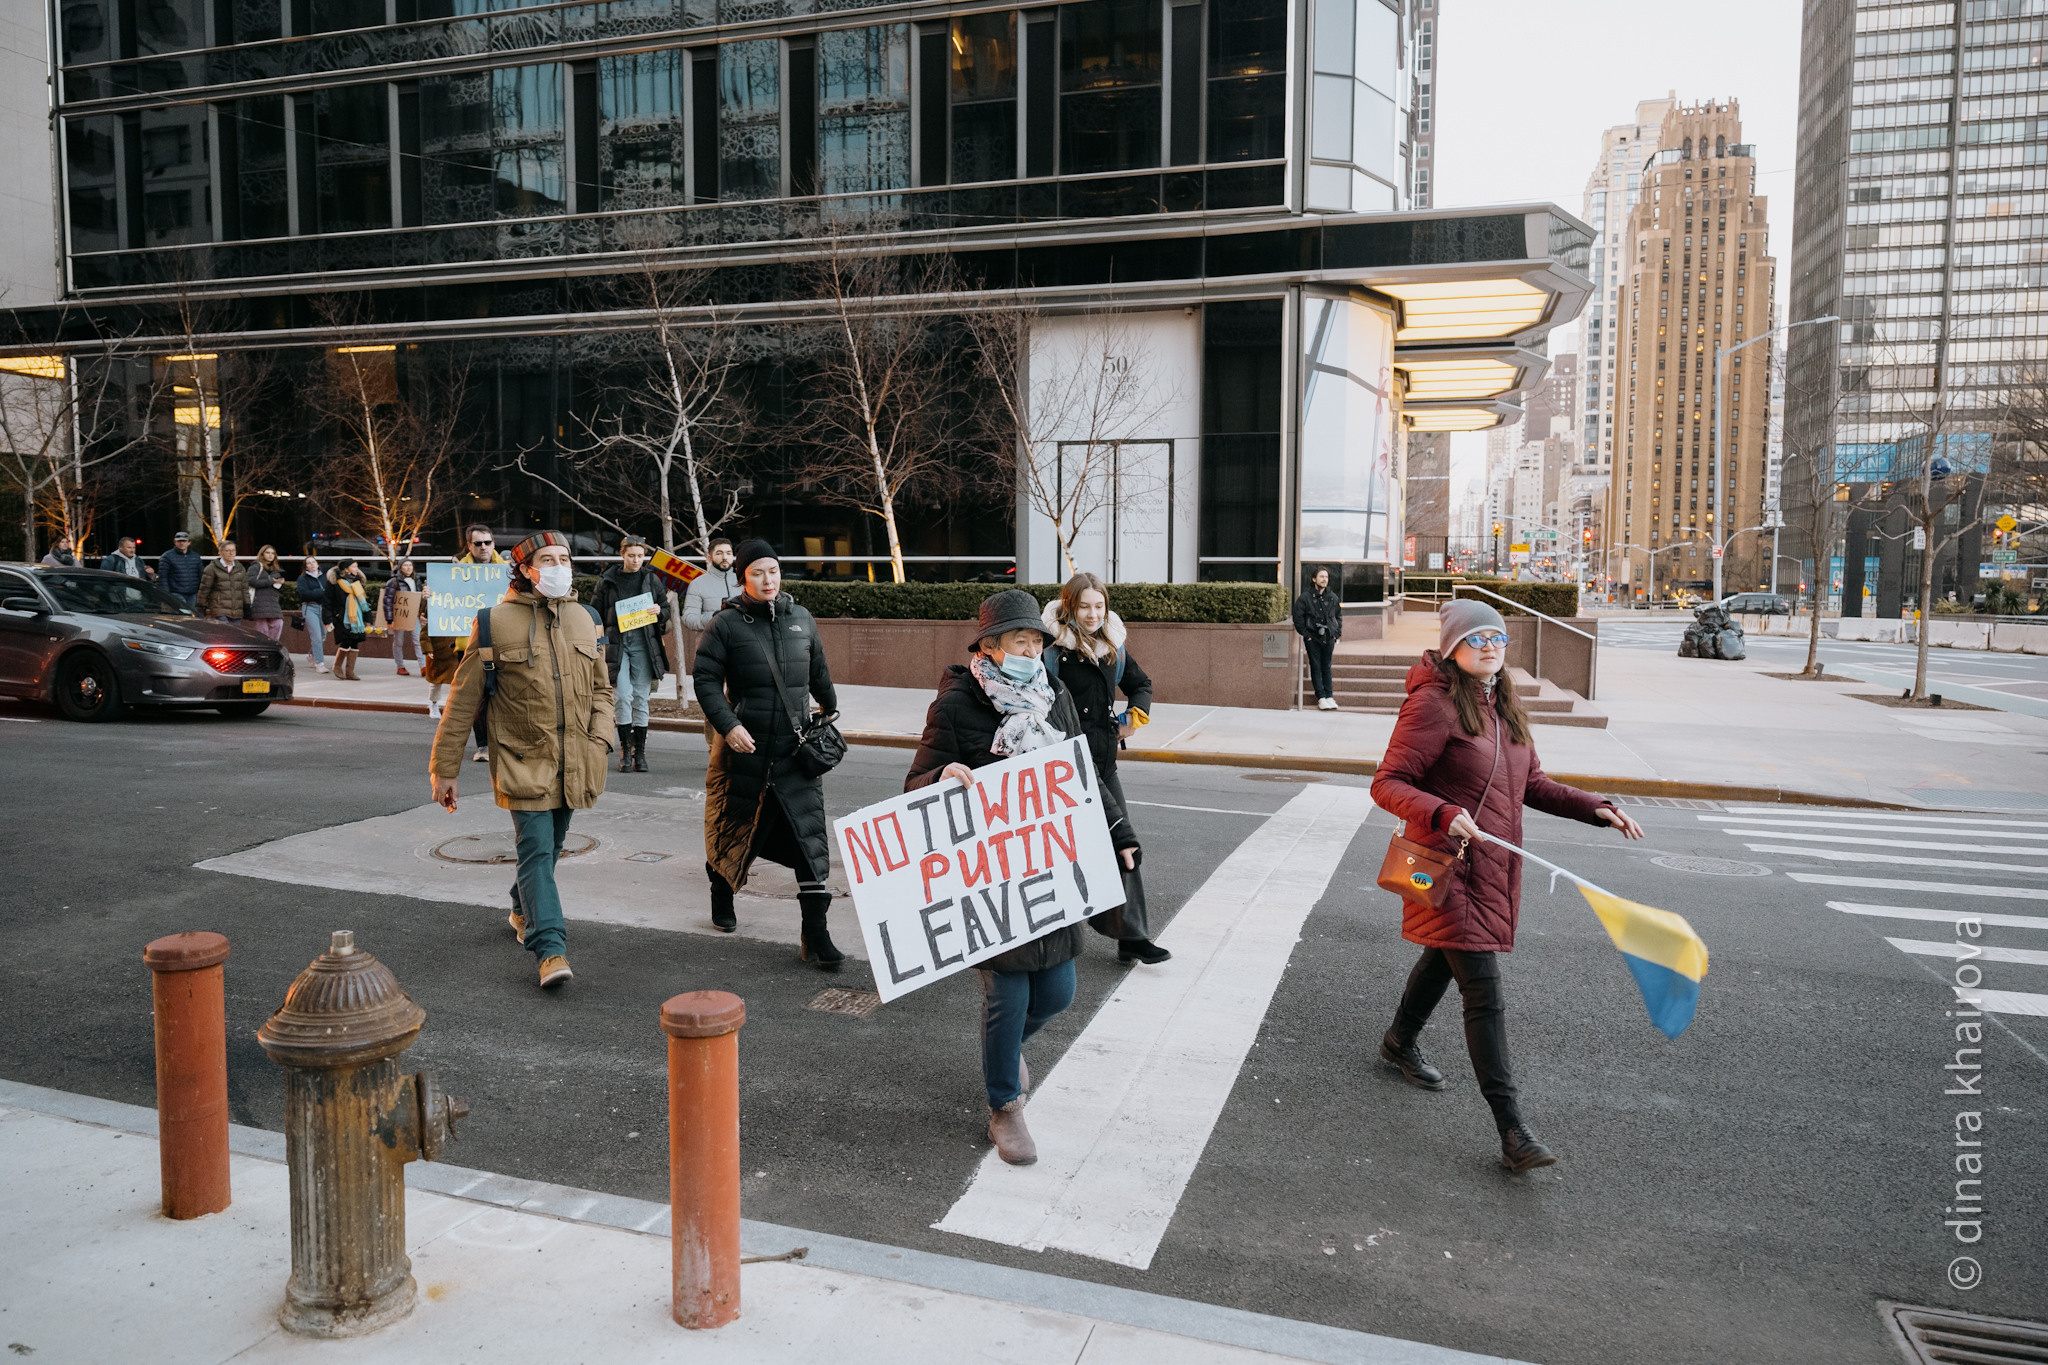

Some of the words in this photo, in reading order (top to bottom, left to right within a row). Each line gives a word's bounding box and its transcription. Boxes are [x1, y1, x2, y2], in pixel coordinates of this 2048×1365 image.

[1104, 355, 1128, 375] 50
[451, 565, 501, 582] PUTIN
[430, 591, 486, 610] HANDS
[1264, 633, 1275, 642] 50
[844, 811, 910, 884] NO
[907, 785, 976, 855] TO
[976, 739, 1094, 831] WAR!
[919, 813, 1079, 904] PUTIN
[1414, 876, 1427, 886] UA
